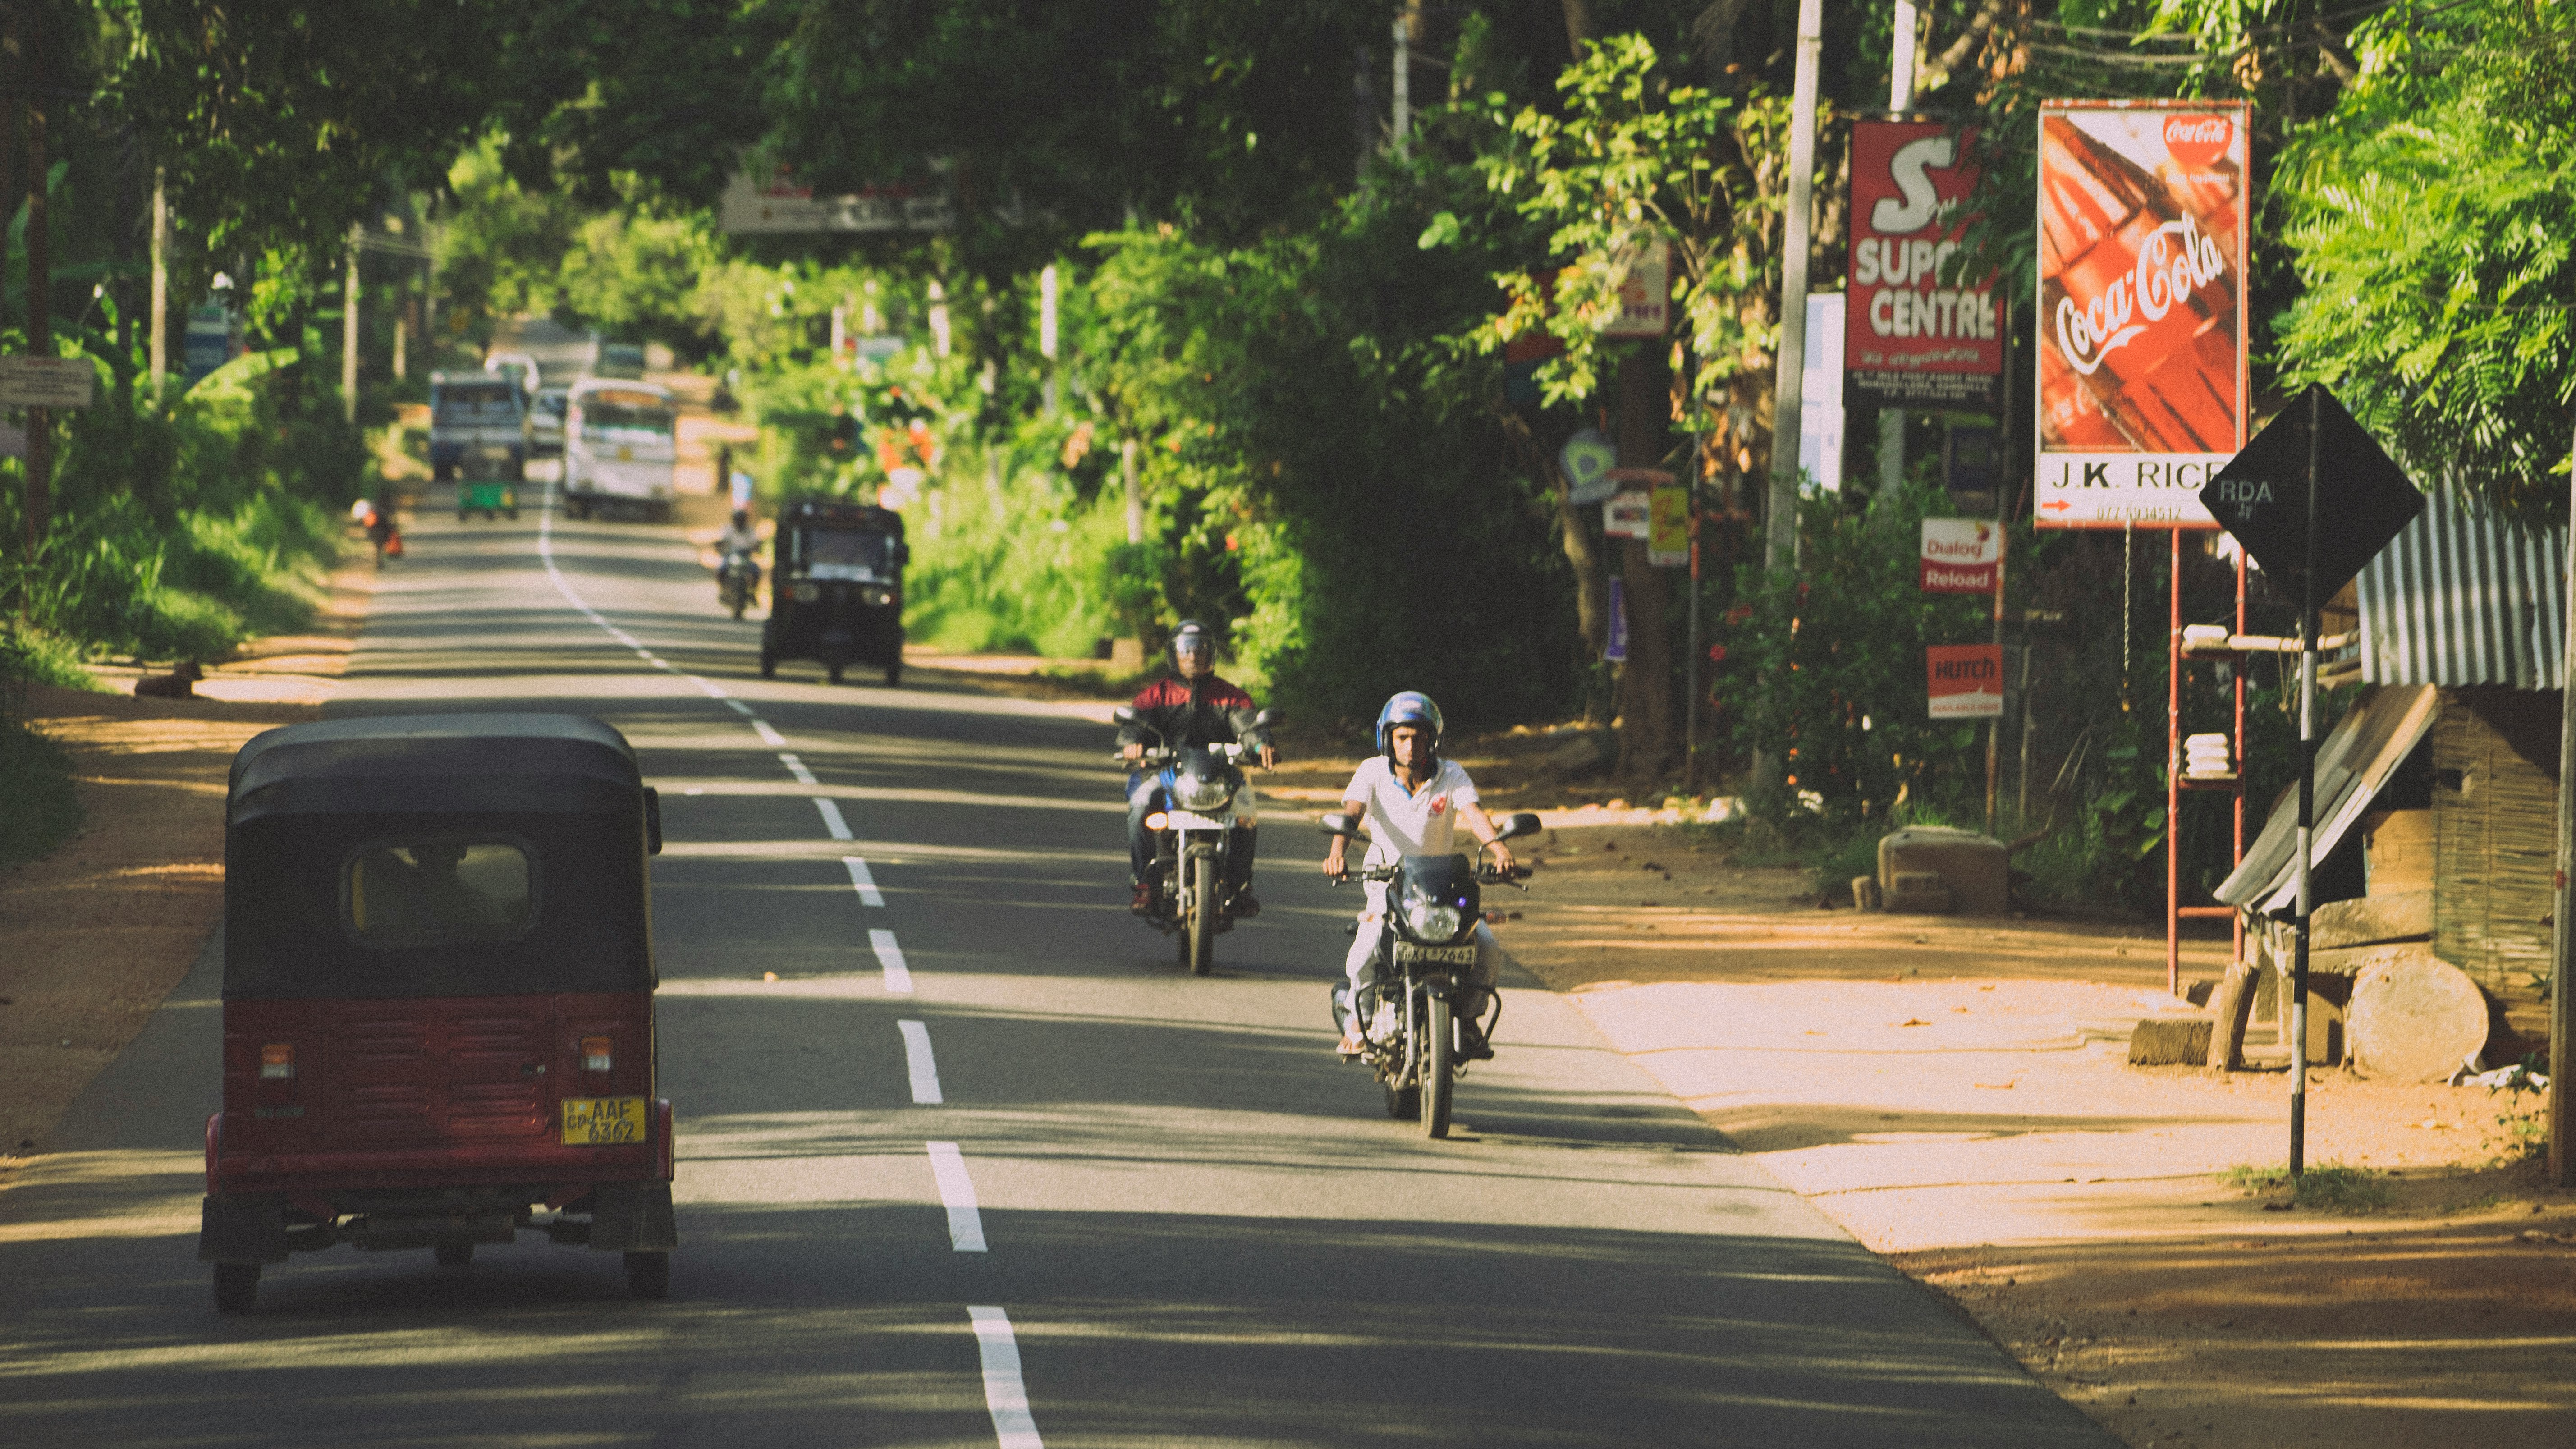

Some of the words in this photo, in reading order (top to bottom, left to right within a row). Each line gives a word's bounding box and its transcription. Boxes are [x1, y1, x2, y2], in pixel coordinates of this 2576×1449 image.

[1871, 136, 1952, 234] S
[1856, 237, 1982, 288] SUP
[2056, 210, 2223, 375] Coca-Cola
[1870, 289, 1996, 340] CENTRE
[2052, 462, 2120, 488] J.K.
[2219, 480, 2273, 502] RDA
[1927, 540, 1983, 559] Dialog
[1926, 570, 1989, 587] Reload
[592, 1098, 631, 1121] AAF
[589, 1118, 634, 1142] 6362
